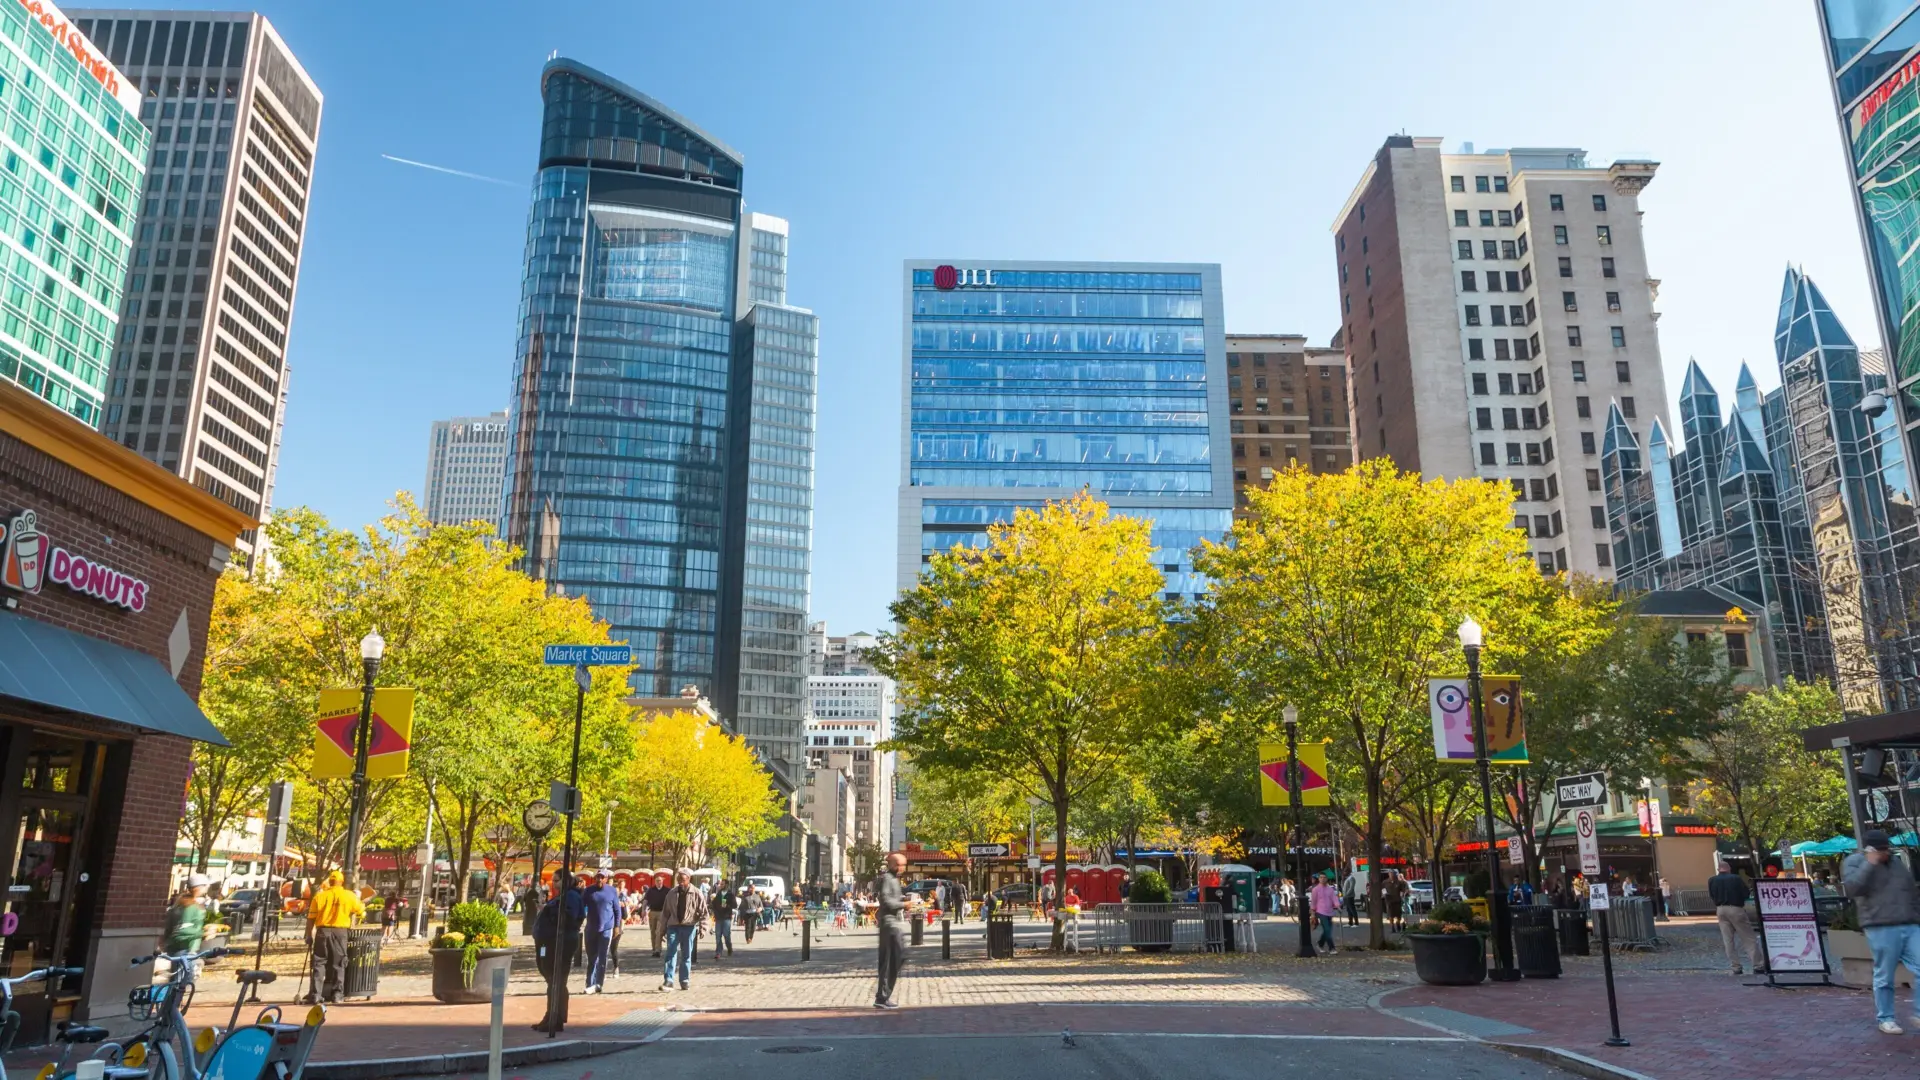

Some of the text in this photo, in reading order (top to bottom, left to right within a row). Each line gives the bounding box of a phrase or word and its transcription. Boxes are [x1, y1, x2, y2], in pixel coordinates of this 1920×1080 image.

[19, 0, 119, 98] eed Smith
[957, 269, 997, 286] JLL
[23, 561, 36, 571] DD
[53, 550, 145, 610] DONUTS
[547, 647, 629, 664] Market Square
[320, 706, 358, 718] MARKET
[1562, 783, 1592, 800] ONE WAY
[1761, 887, 1797, 899] HOPS
[1768, 896, 1809, 909] for hope
